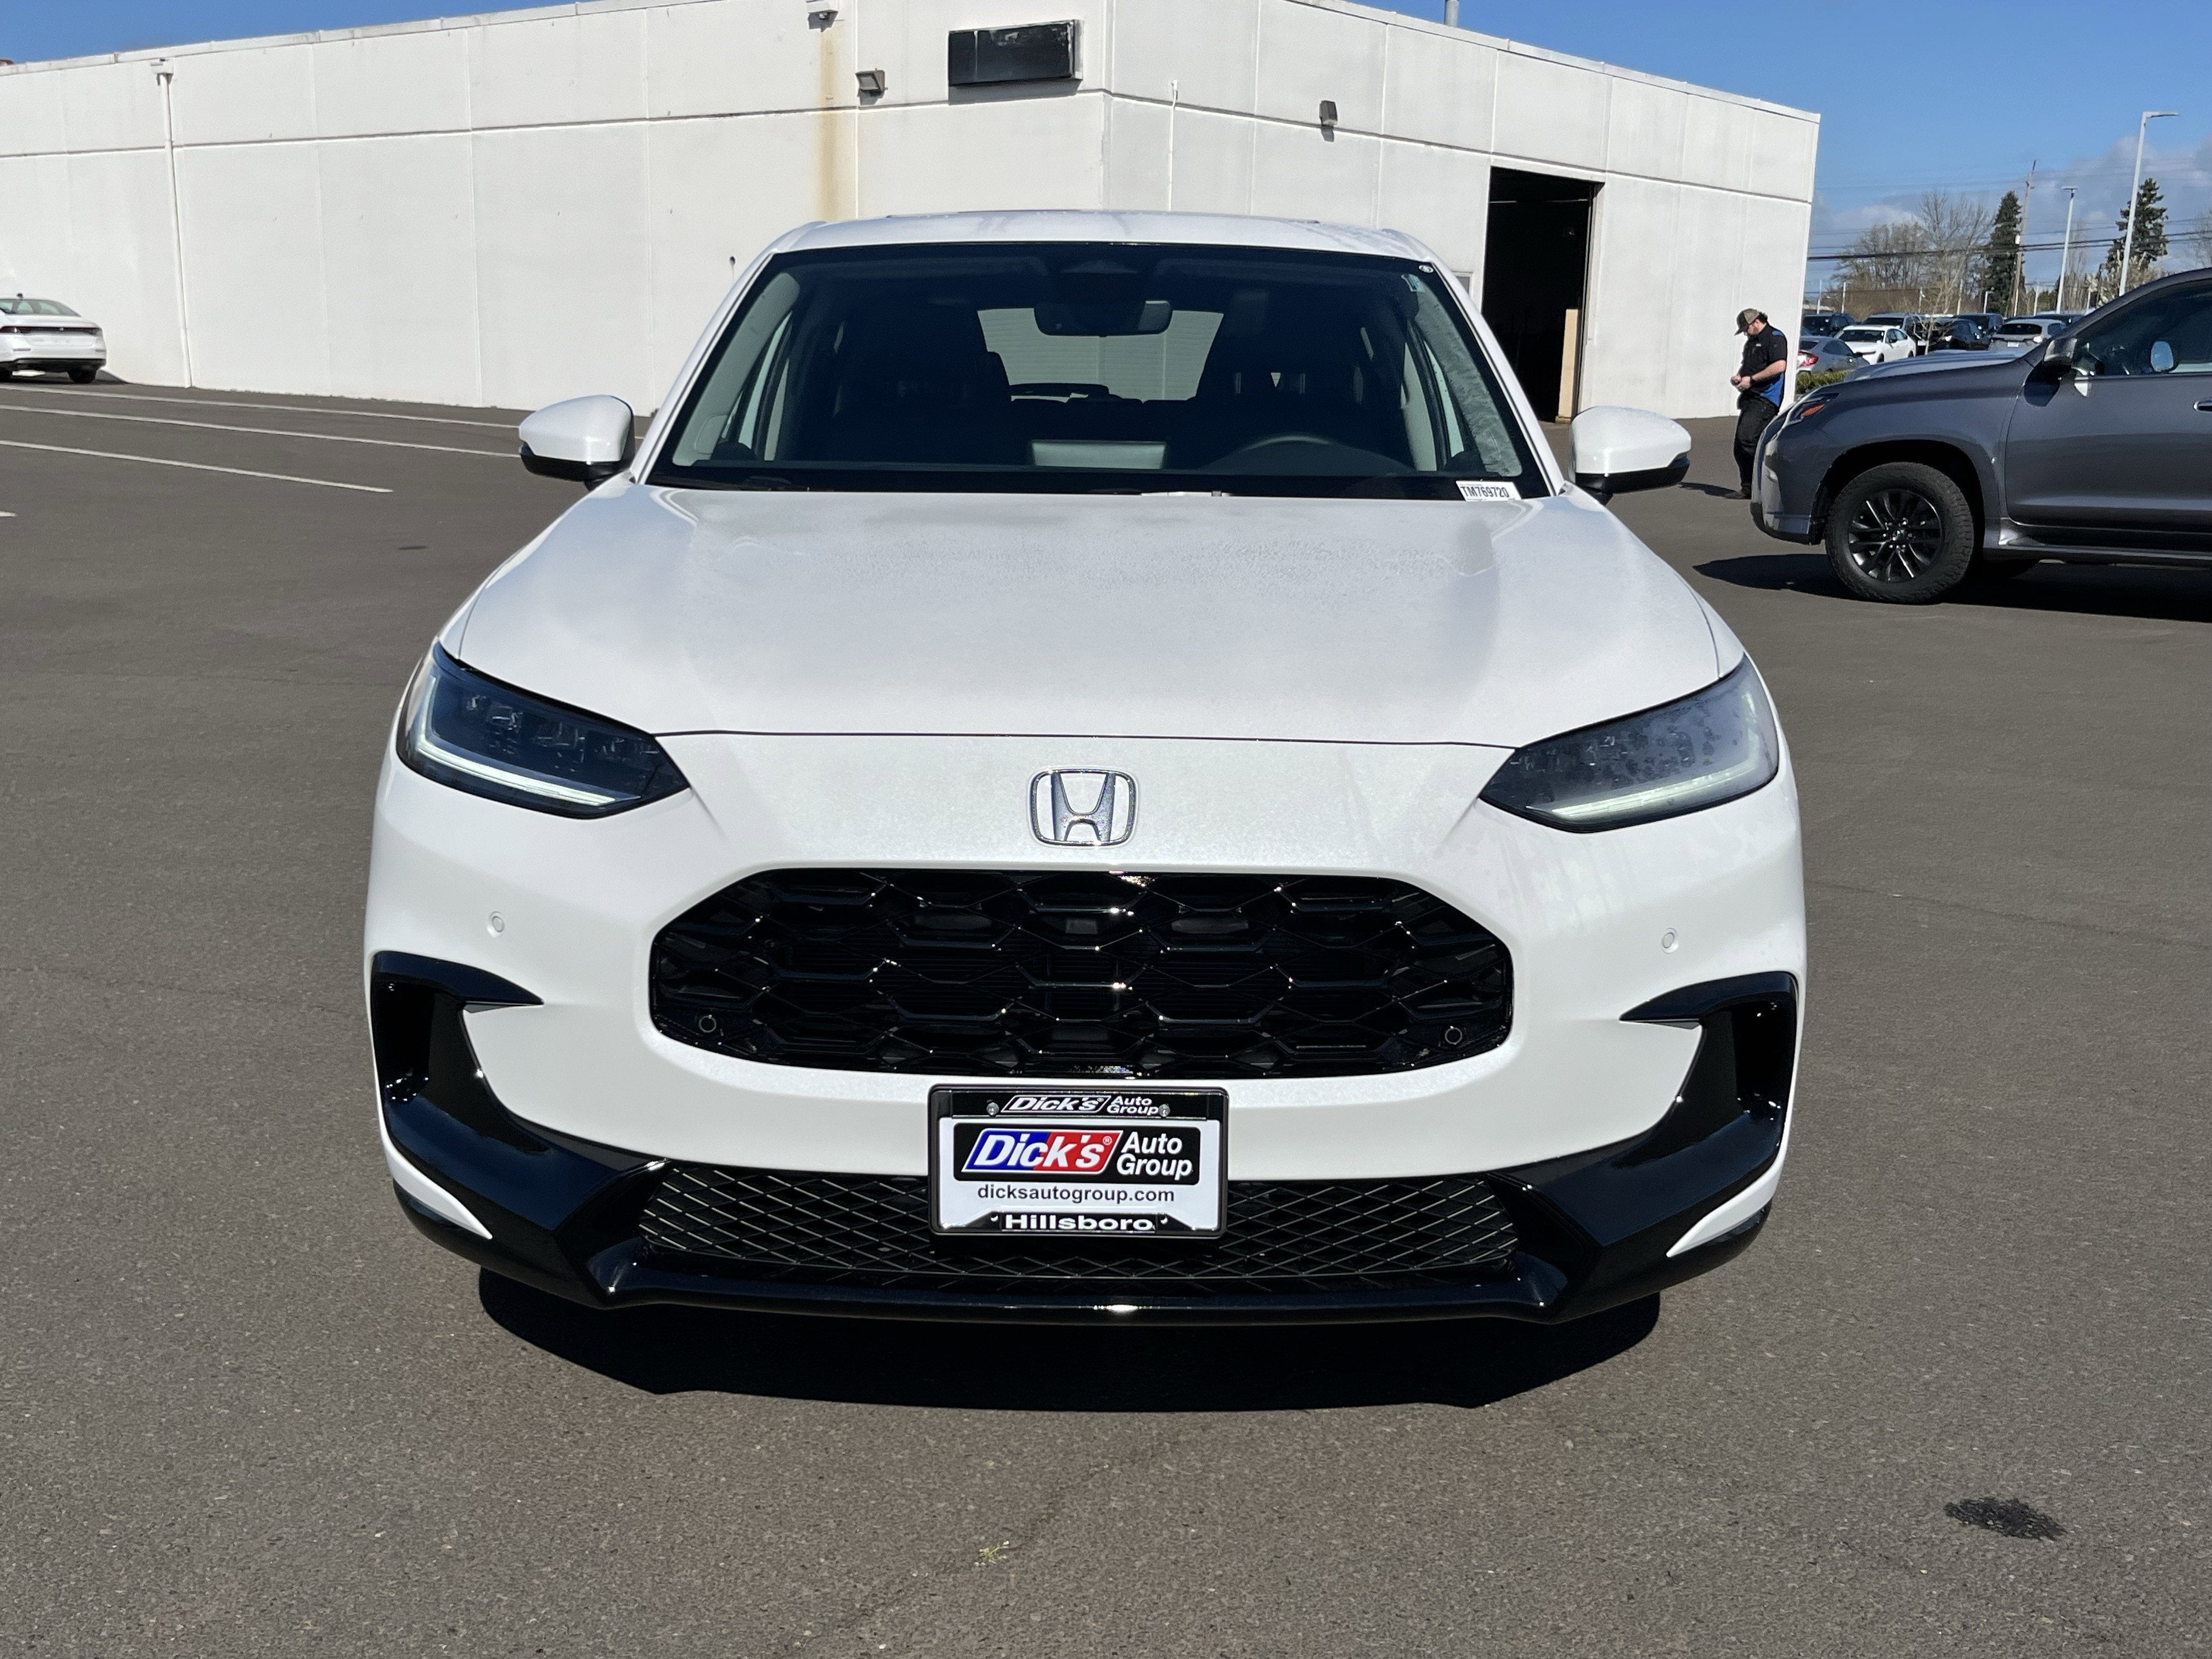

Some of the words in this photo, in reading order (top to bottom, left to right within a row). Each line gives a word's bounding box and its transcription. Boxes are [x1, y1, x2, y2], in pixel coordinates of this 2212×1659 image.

[1460, 486, 1509, 498] TM769720
[1008, 1096, 1099, 1111] Dick's
[1111, 1095, 1152, 1105] Auto
[1107, 1104, 1159, 1116] Group
[973, 1133, 1105, 1169] Dick's
[1120, 1131, 1183, 1155] Auto
[1116, 1155, 1193, 1180] Group
[977, 1184, 1175, 1204] dicksautogroup.com
[1005, 1214, 1153, 1231] Hillsboro
